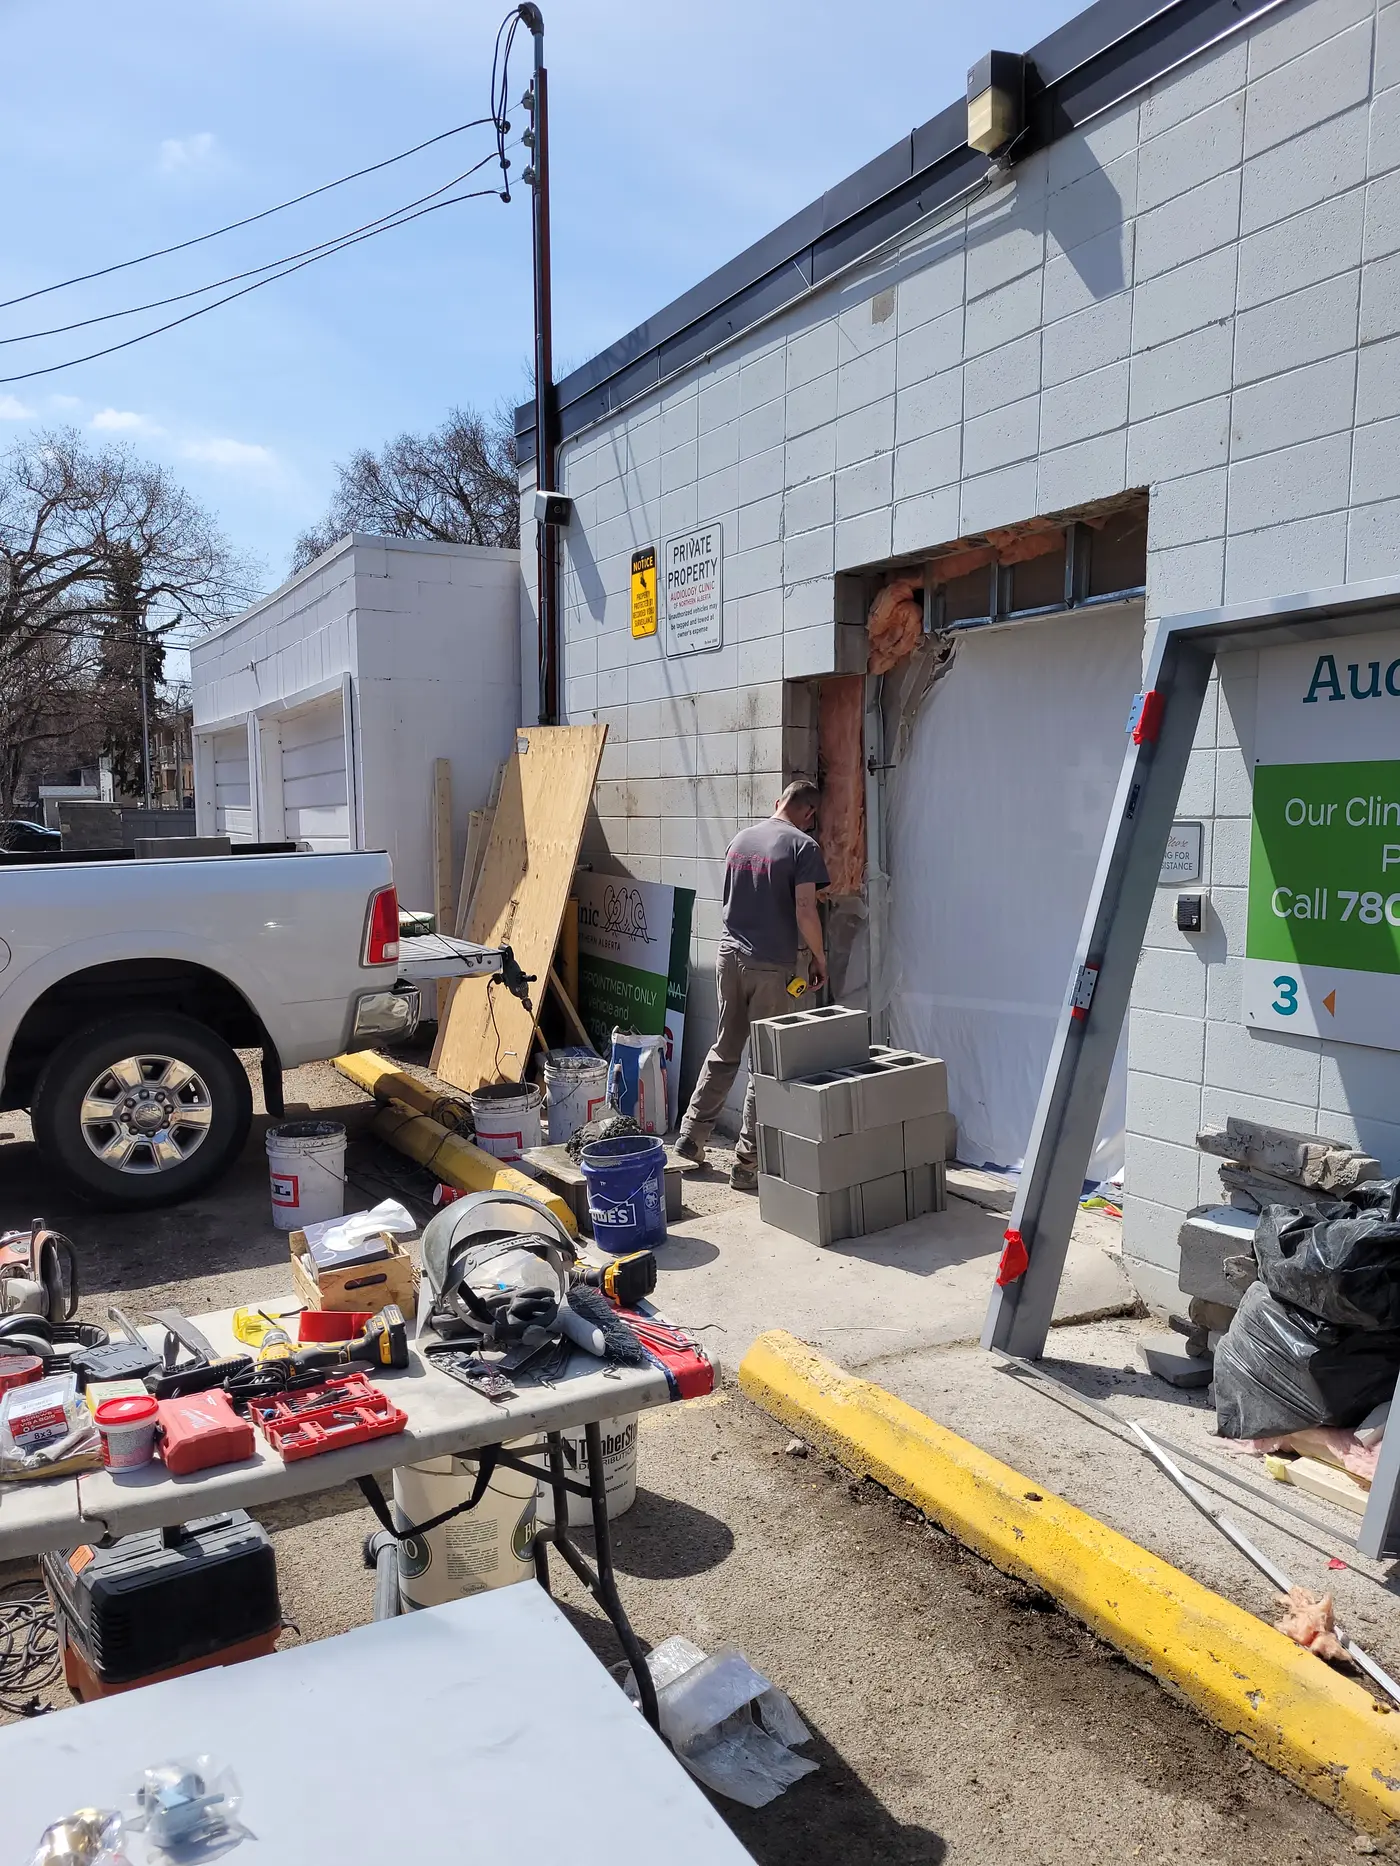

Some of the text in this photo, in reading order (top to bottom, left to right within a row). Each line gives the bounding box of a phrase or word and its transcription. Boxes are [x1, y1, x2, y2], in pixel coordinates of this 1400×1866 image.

[674, 535, 712, 565] PRIVATE
[634, 557, 653, 572] NOTICE
[668, 558, 718, 590] PROPERTY
[671, 581, 715, 601] AUDIOLOGY CLINIC
[694, 605, 709, 614] vehicles
[1285, 795, 1400, 827] Our Clin
[1174, 851, 1190, 860] FOR
[578, 901, 600, 928] nic
[1271, 886, 1328, 920] Call
[598, 938, 621, 952] ALBERTA
[633, 985, 658, 1008] ONLY
[1271, 975, 1299, 1016] 3
[613, 1005, 630, 1021] and
